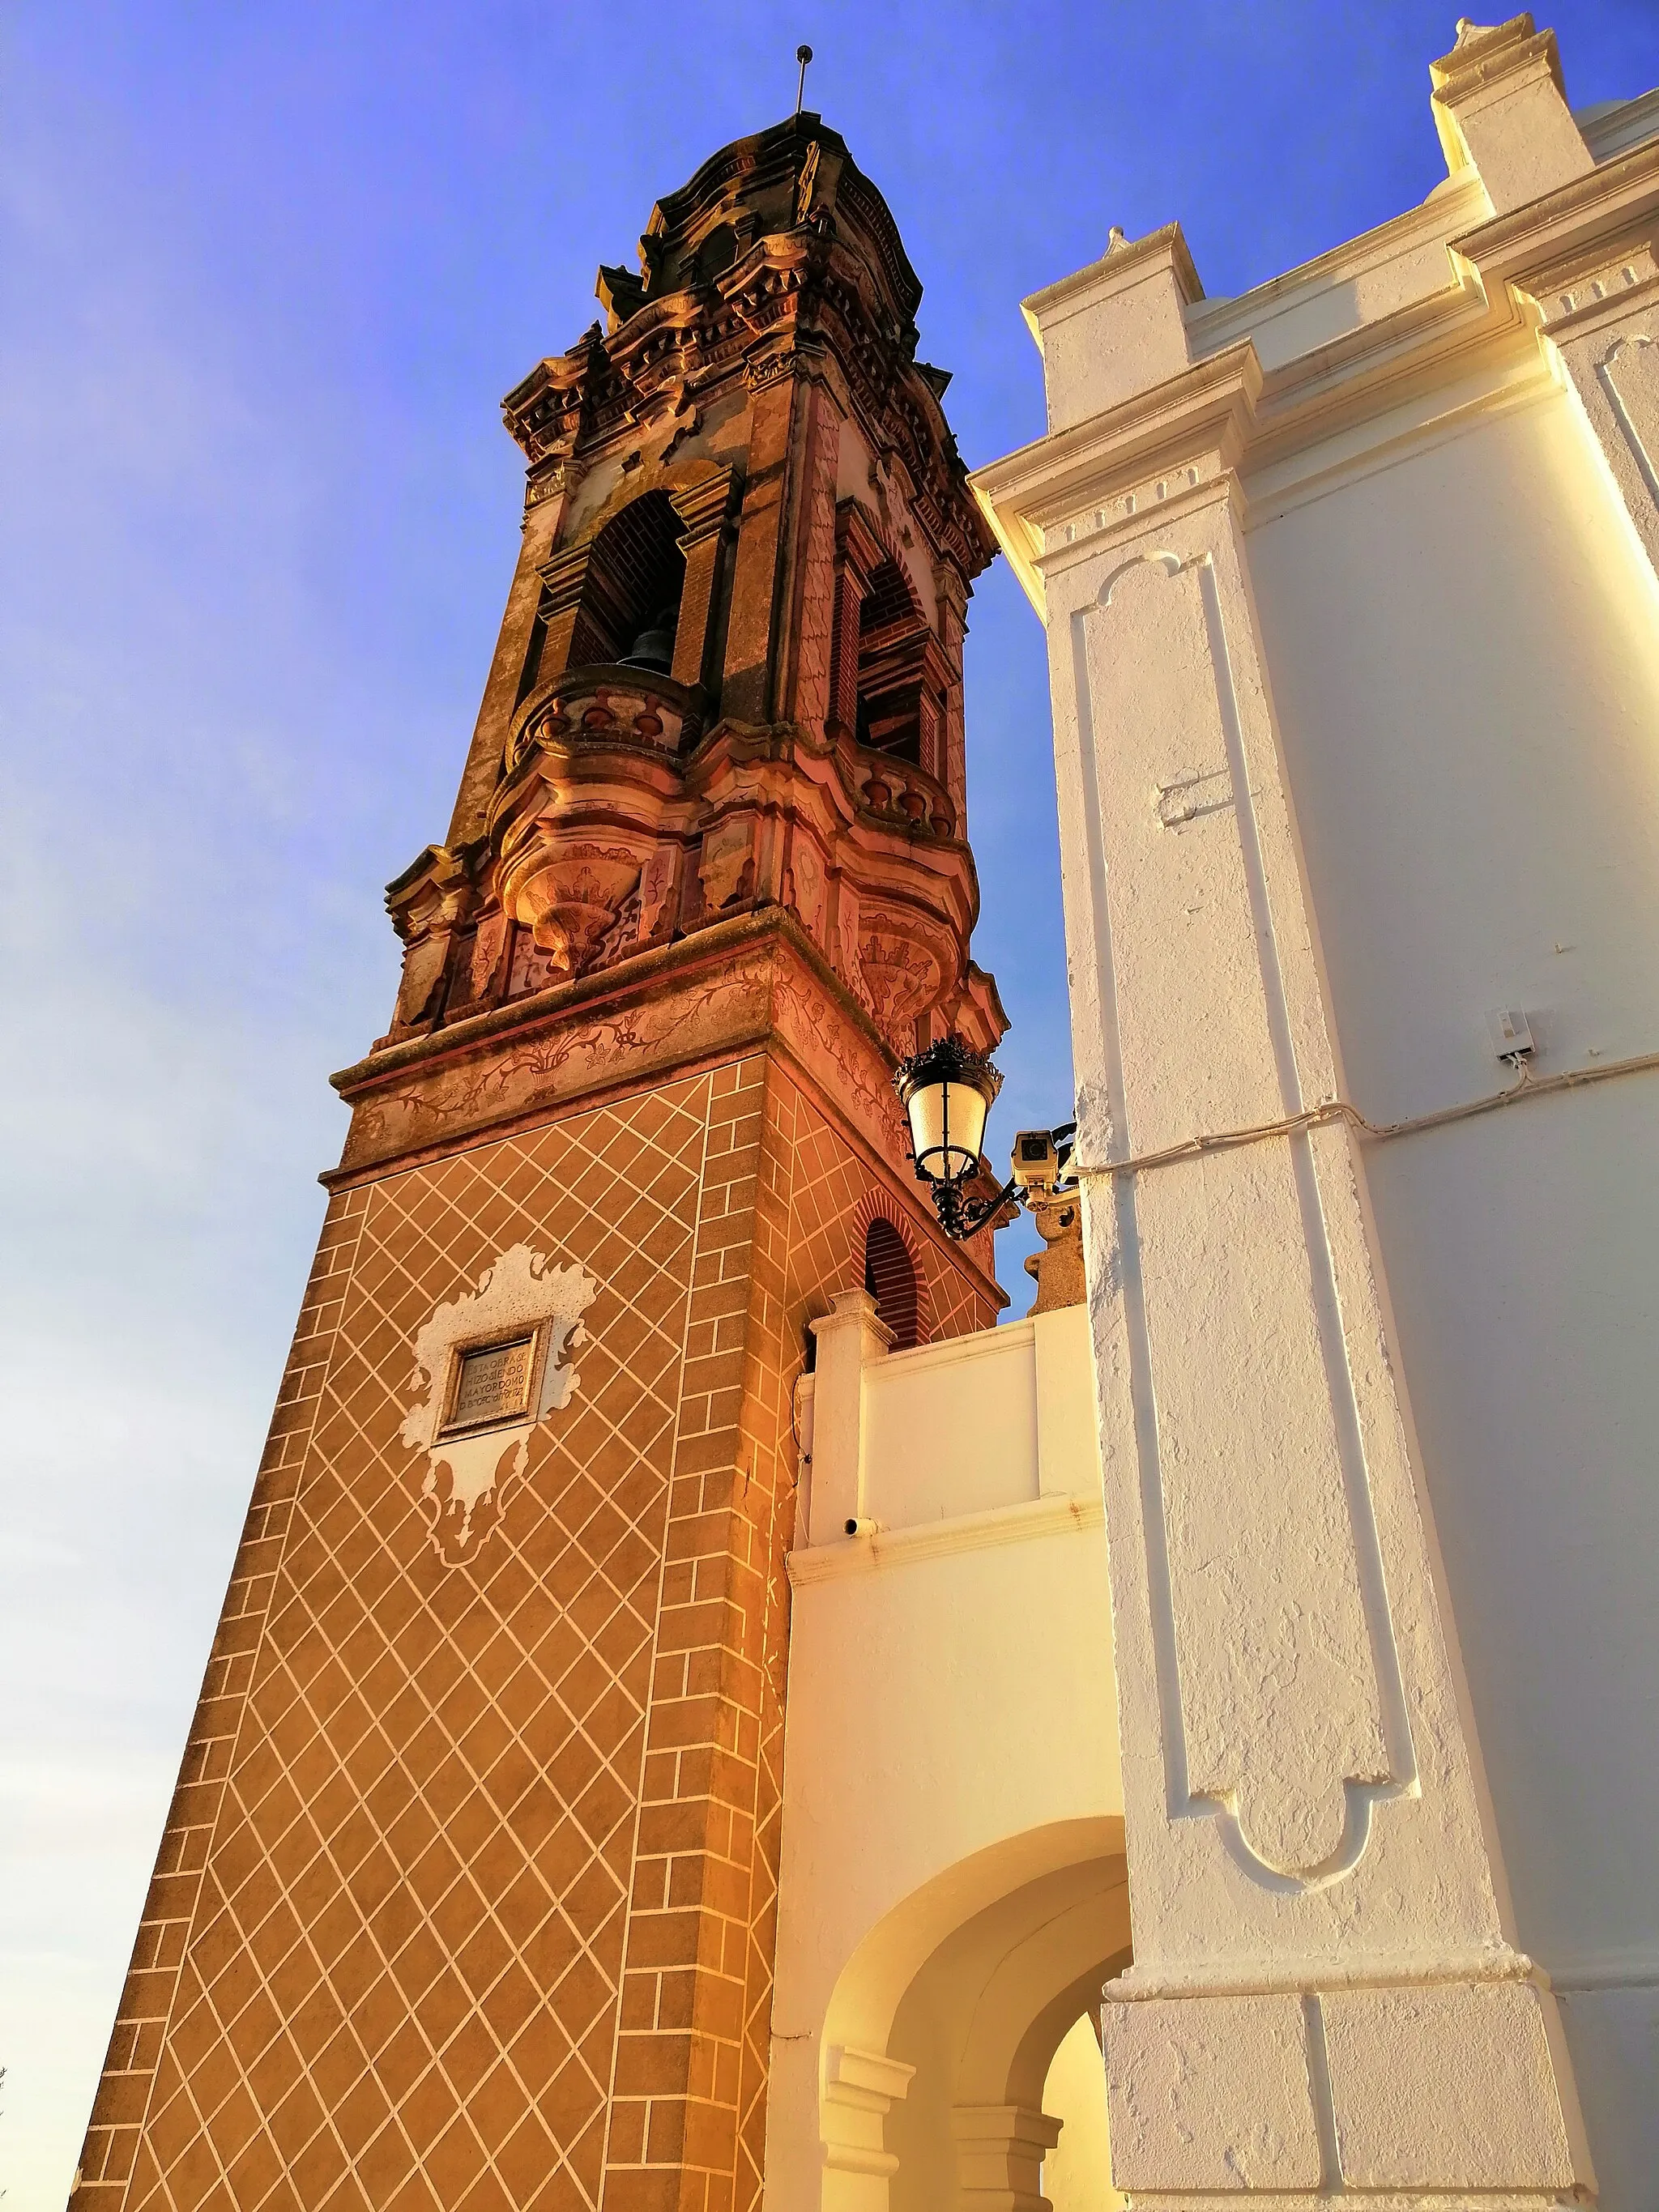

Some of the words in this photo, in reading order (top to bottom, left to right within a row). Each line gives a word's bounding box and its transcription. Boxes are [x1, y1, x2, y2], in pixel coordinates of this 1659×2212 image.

[490, 1357, 515, 1368] OBRA
[517, 1353, 527, 1361] SE
[467, 1374, 488, 1386] HIZO
[489, 1365, 523, 1379] SIENDO
[465, 1375, 524, 1398] MAYORDOMO
